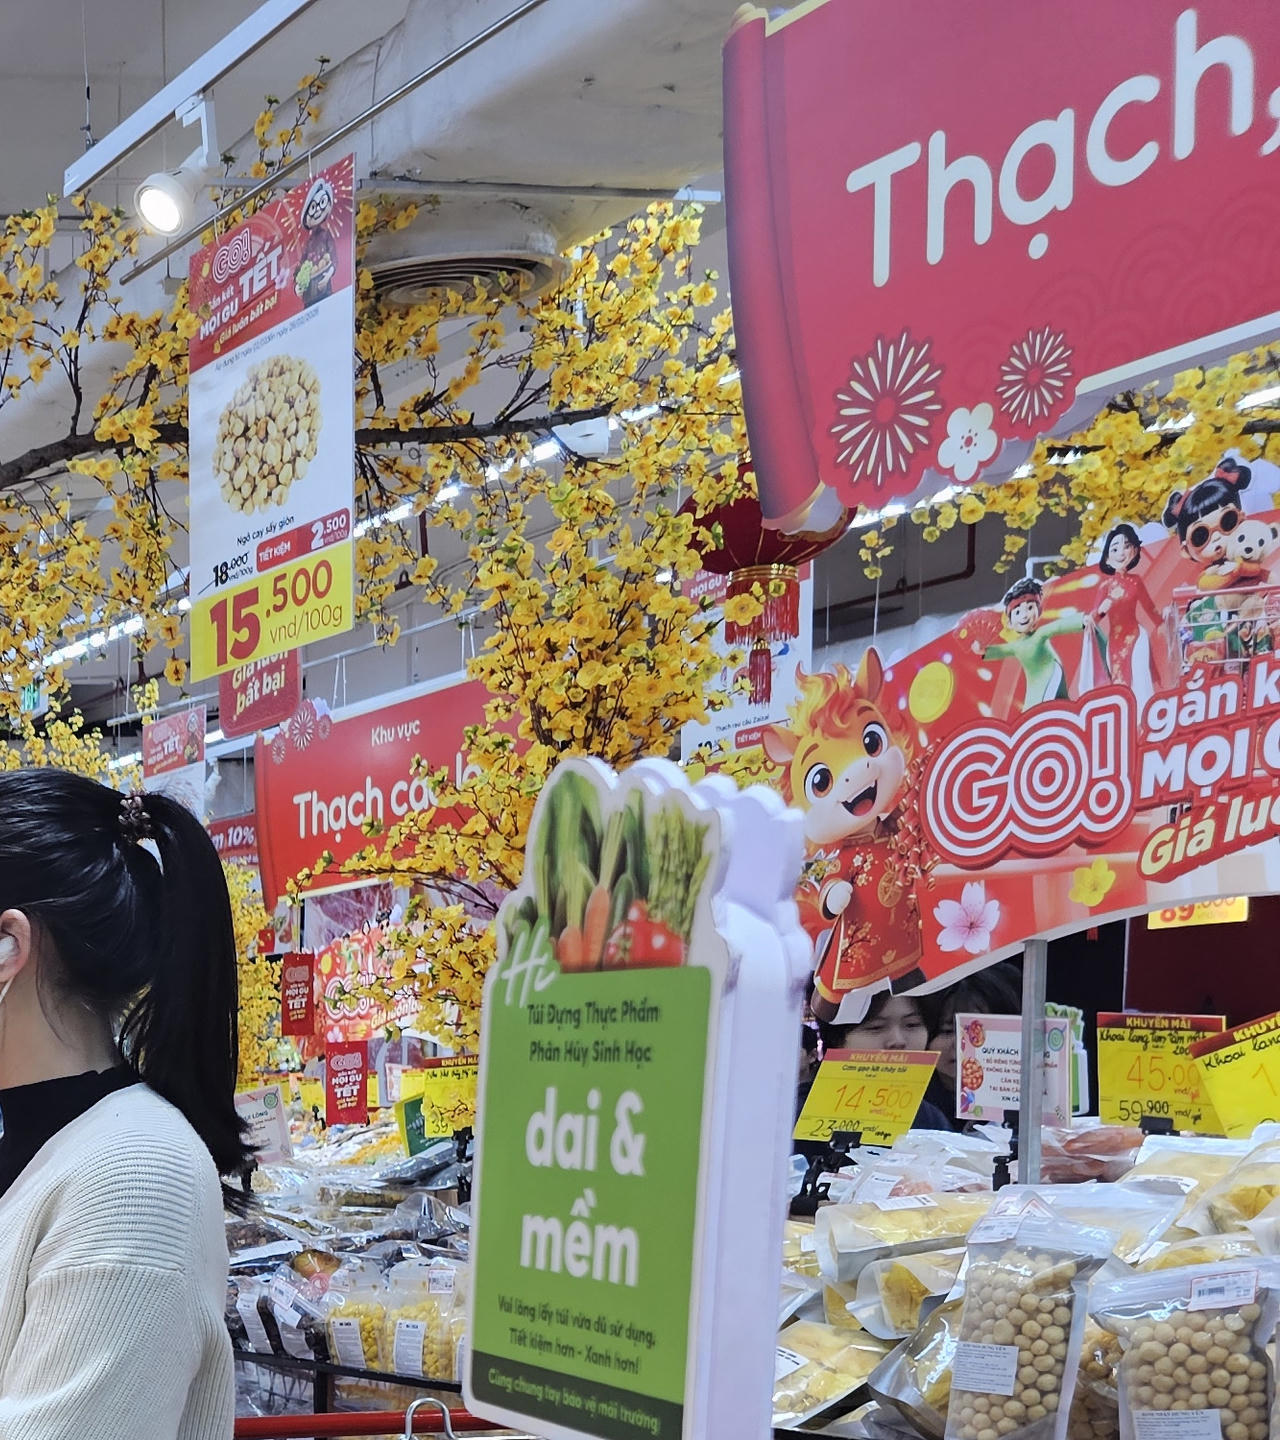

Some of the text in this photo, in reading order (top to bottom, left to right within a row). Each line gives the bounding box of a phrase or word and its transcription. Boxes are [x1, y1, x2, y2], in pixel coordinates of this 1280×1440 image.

[239, 241, 282, 303] TẾT
[199, 297, 239, 341] MỌI GU
[209, 559, 333, 668] 15.500
[269, 604, 343, 645] vnd/100g
[261, 664, 286, 697] bại
[1144, 667, 1239, 743] gắn
[370, 717, 421, 747] Khu vực
[926, 694, 1130, 858] GO!
[1139, 727, 1250, 801] MỌI
[292, 775, 384, 842] Thạch
[227, 825, 256, 847] 10%
[1140, 804, 1217, 877] Giá
[526, 997, 660, 1031] Túi Đựng Thực Phẩm
[1125, 1014, 1191, 1029] KHUYẾN MÃI
[529, 1040, 561, 1064] Phân
[591, 1039, 621, 1063] Sinh
[624, 1040, 653, 1070] Học
[332, 1074, 363, 1087] MỌI GU
[333, 1083, 360, 1099] TẾT
[1126, 1056, 1202, 1092] 45.00
[833, 1083, 914, 1115] 14.500
[525, 1086, 600, 1172] dai
[609, 1090, 646, 1177] &
[519, 1187, 640, 1288] mềm
[514, 1299, 536, 1322] lòng
[529, 1331, 553, 1356] kiệm
[554, 1338, 575, 1358] hơn
[584, 1345, 612, 1368] Xanh
[488, 1367, 513, 1392] Cùng
[514, 1376, 544, 1401] chung
